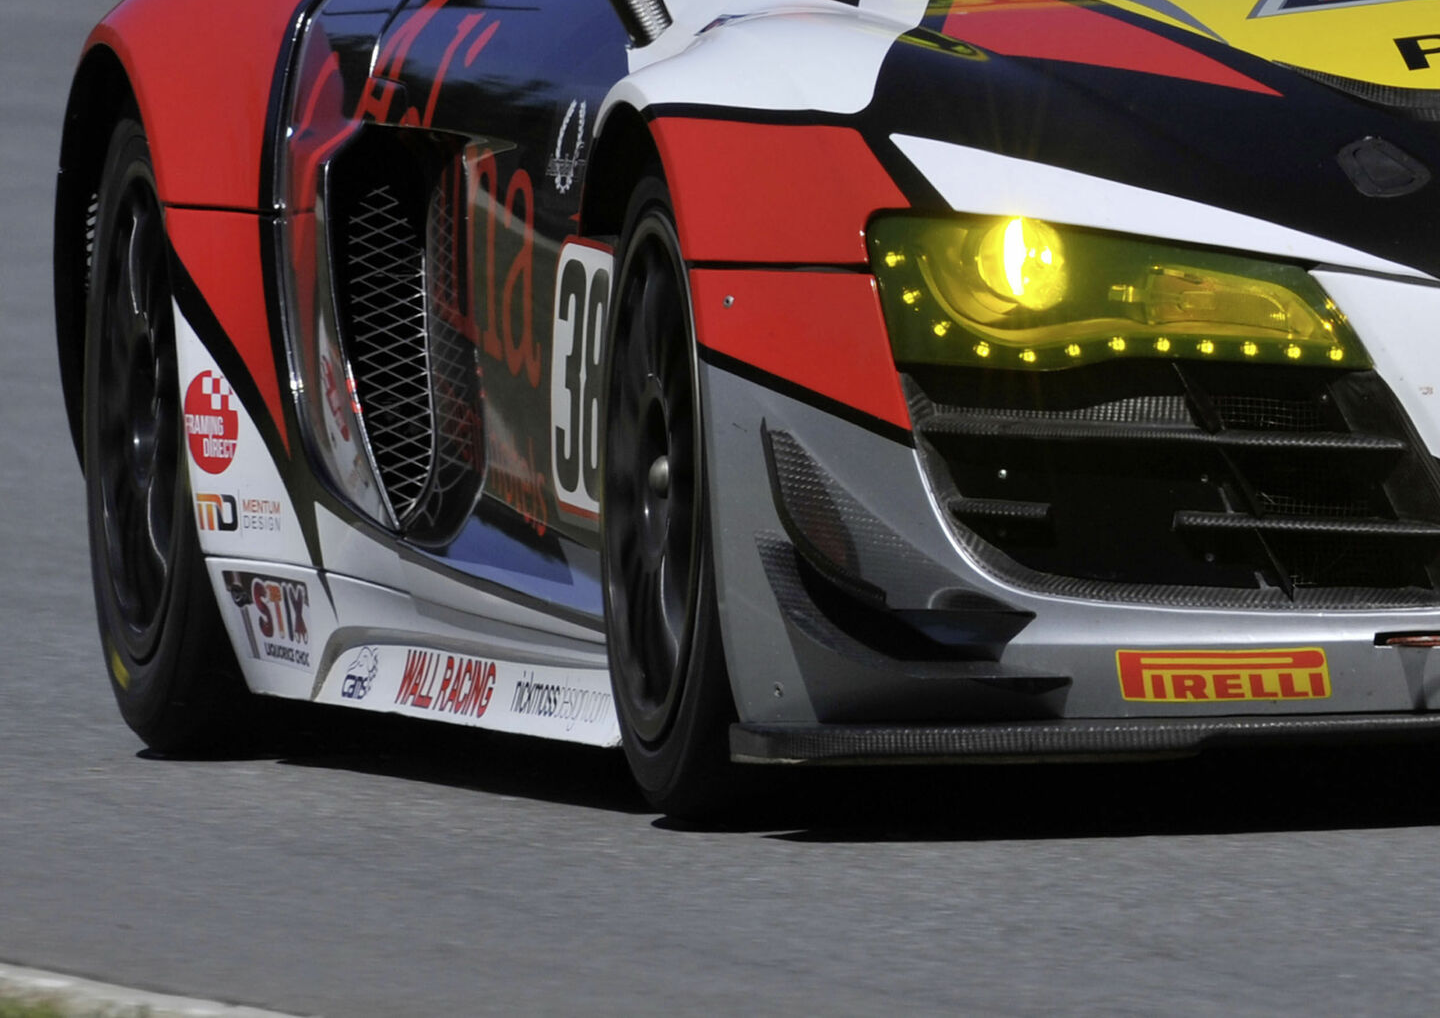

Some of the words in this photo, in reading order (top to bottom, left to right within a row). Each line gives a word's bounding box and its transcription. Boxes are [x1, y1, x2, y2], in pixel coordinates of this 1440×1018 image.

[554, 258, 609, 503] 38
[203, 435, 238, 459] DIRECT
[243, 515, 281, 532] DESIGN
[252, 578, 310, 646] STIX
[394, 649, 442, 710] WALL
[433, 655, 497, 719] RACING
[1118, 649, 1327, 702] PIRELLI
